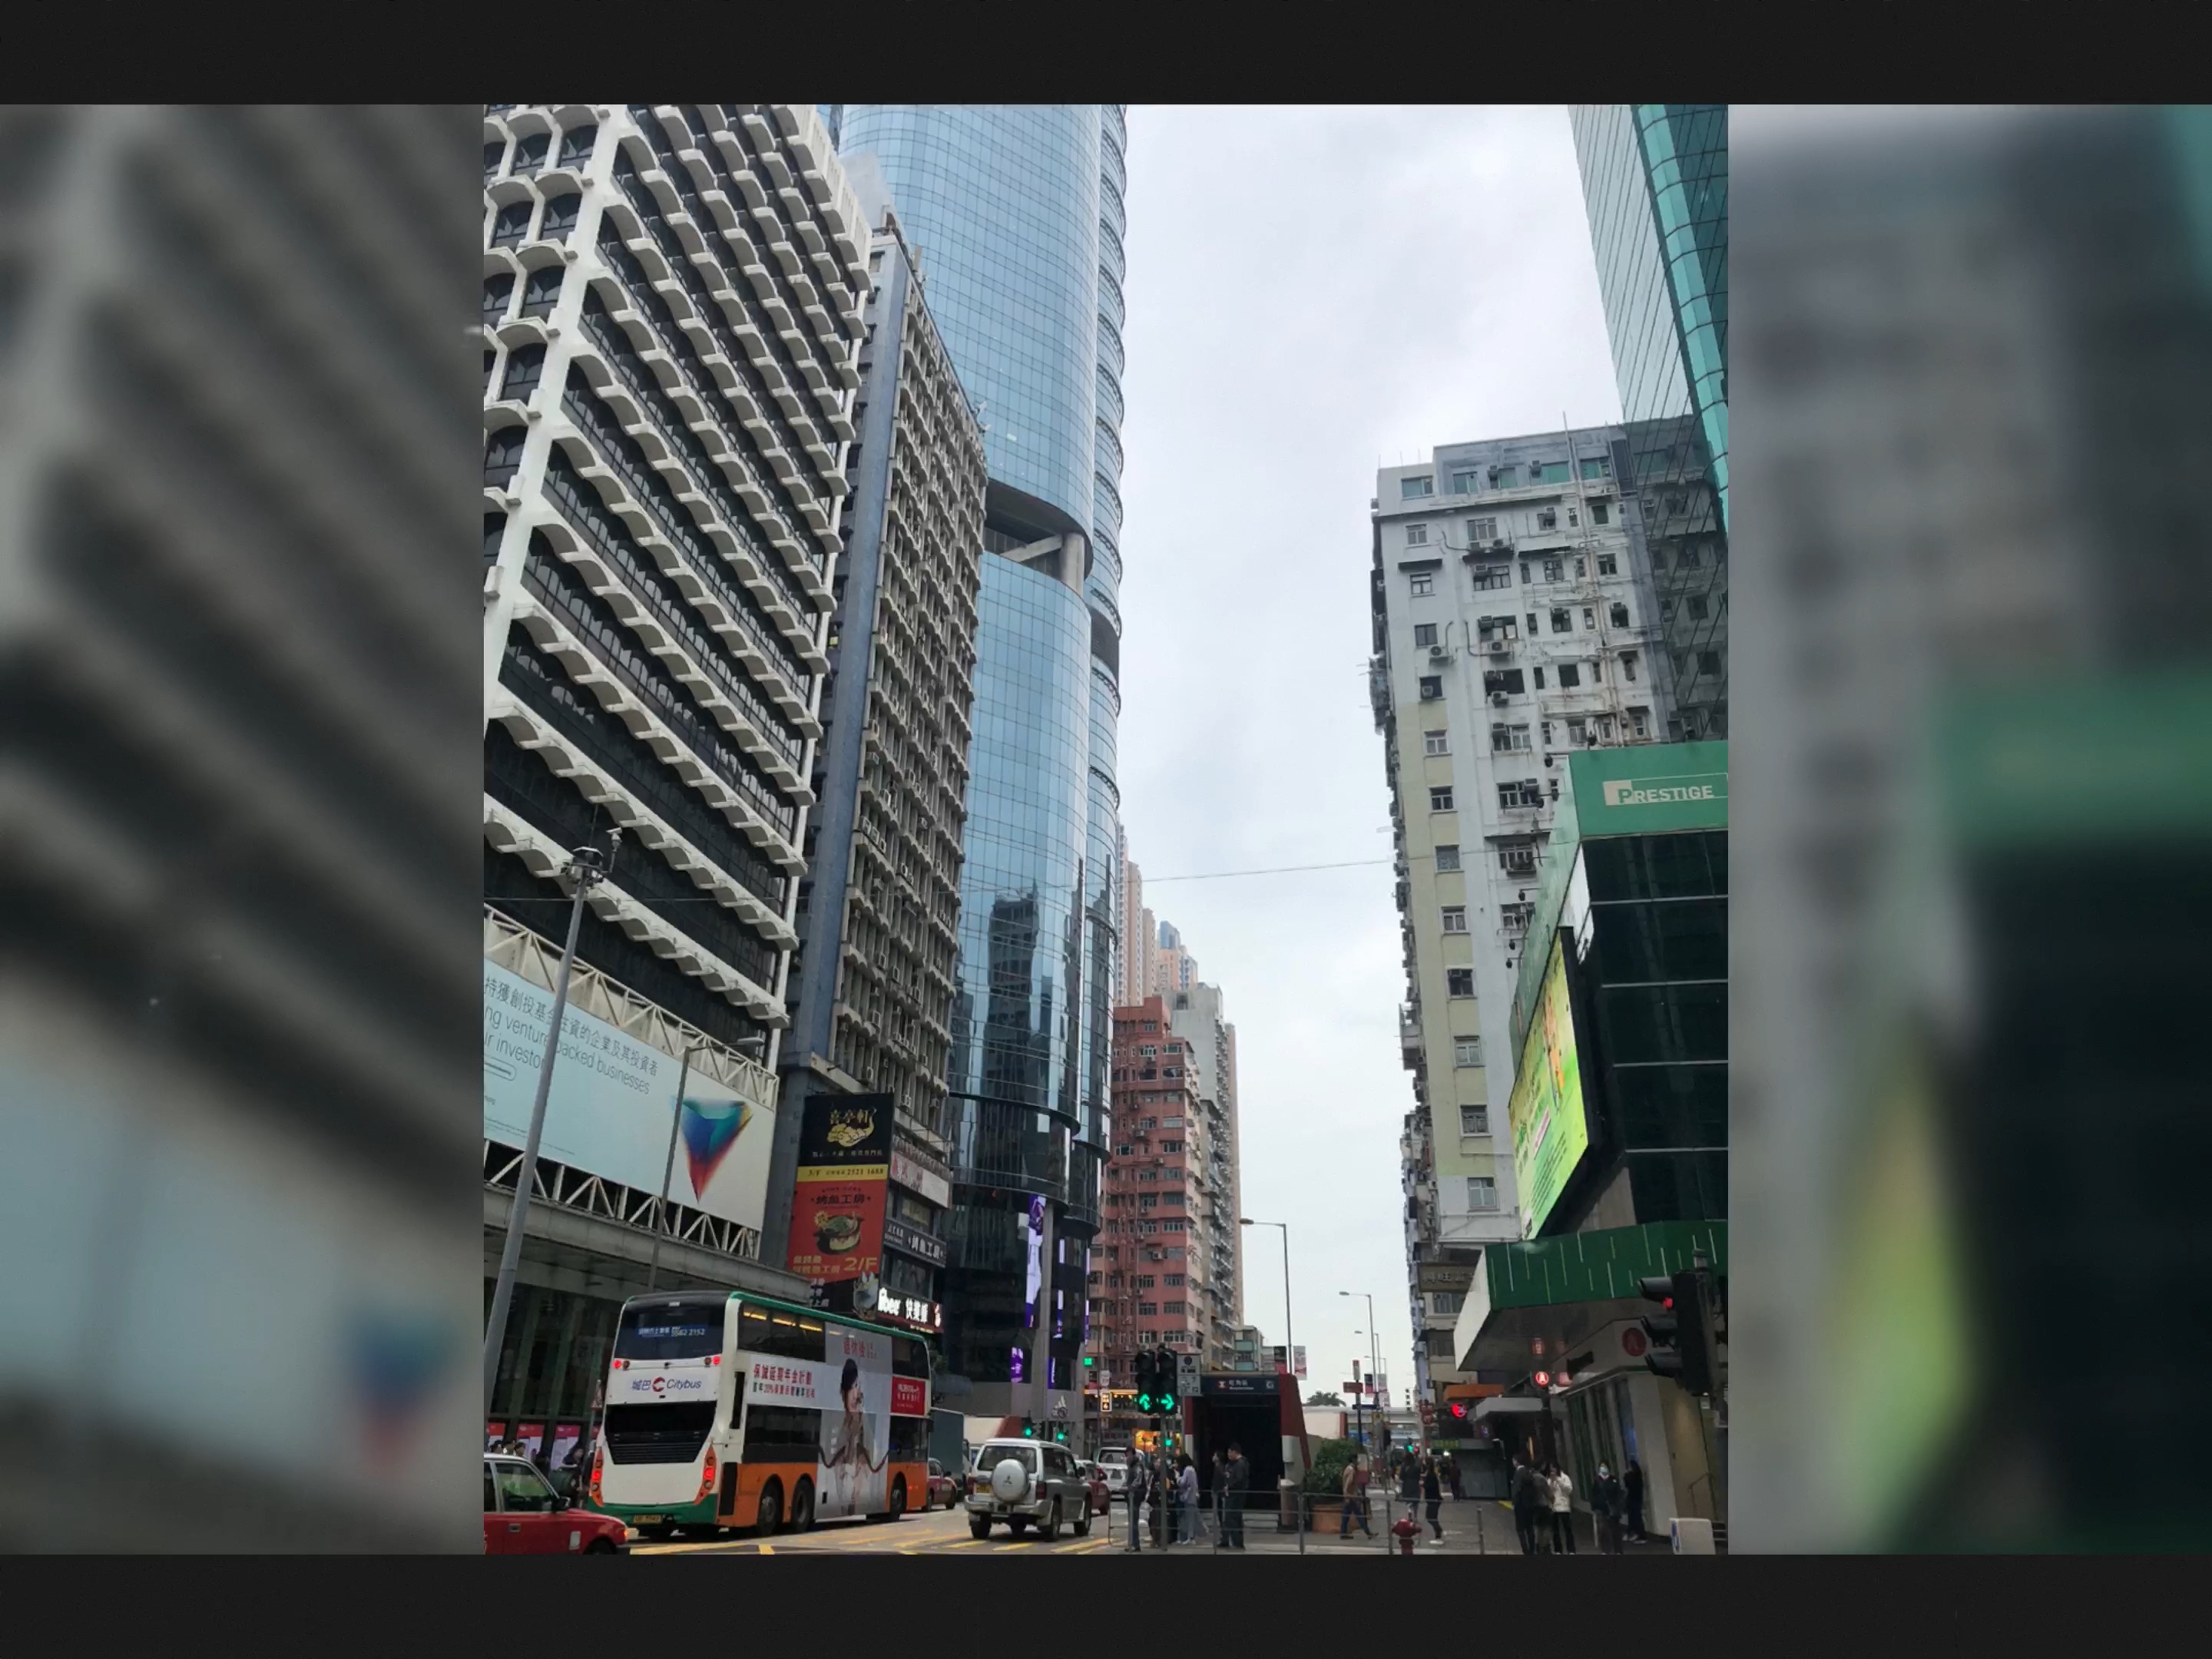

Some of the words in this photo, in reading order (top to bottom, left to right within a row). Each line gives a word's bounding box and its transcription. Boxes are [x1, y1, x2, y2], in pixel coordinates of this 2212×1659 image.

[1618, 785, 1714, 804] PRESTIGE
[597, 1060, 650, 1095] businesses
[844, 1257, 878, 1271] 2/F
[632, 1379, 651, 1391] 城巴
[667, 1379, 701, 1390] Citybus
